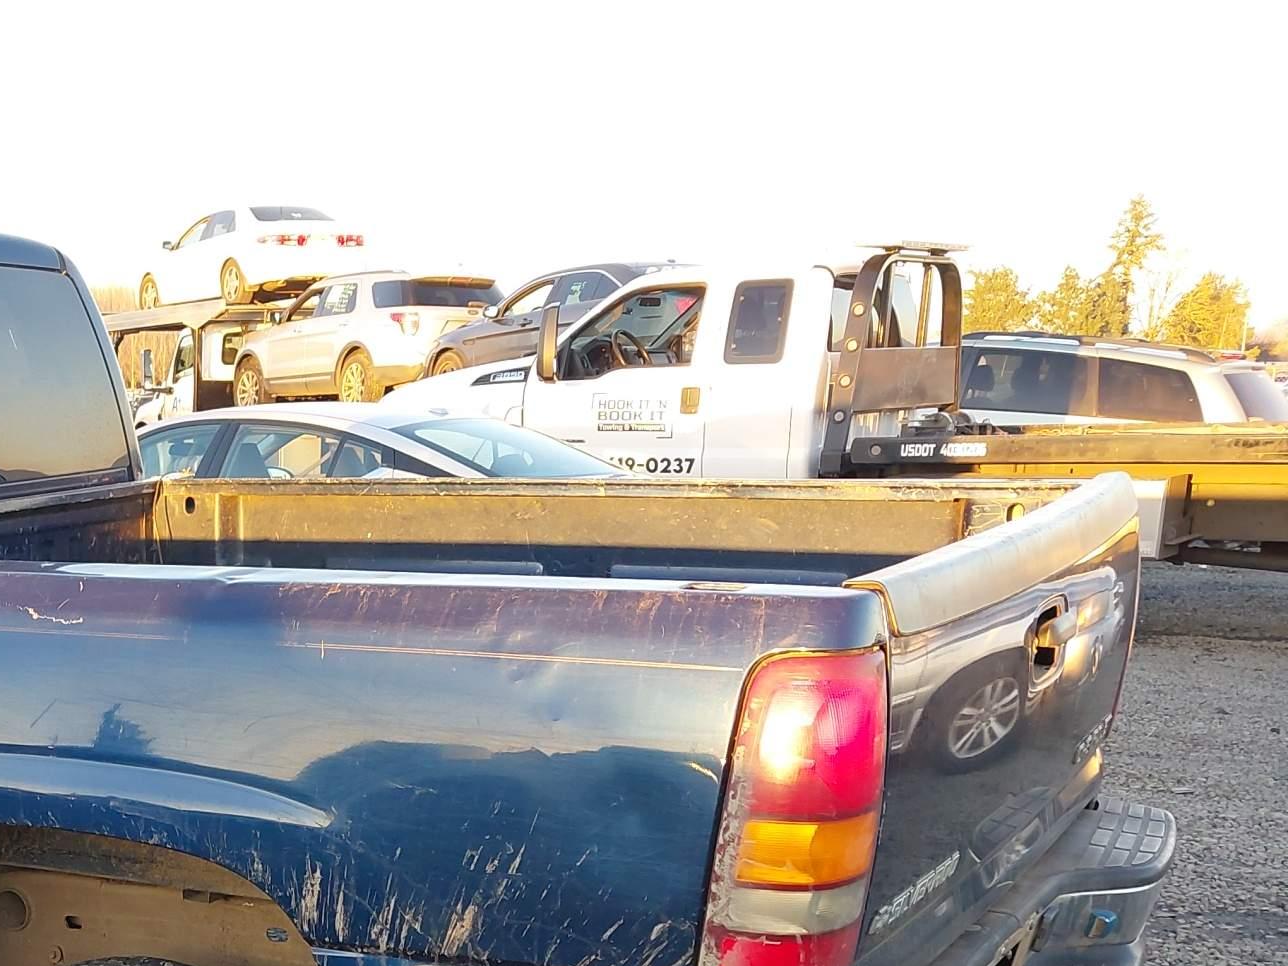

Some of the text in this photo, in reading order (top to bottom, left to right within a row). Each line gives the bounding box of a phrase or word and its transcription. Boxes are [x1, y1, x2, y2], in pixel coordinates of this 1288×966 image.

[598, 399, 633, 409] HOOK
[639, 399, 650, 409] IT
[598, 411, 664, 421] BOOK IT
[599, 424, 623, 432] Towing
[900, 443, 936, 457] USDOT
